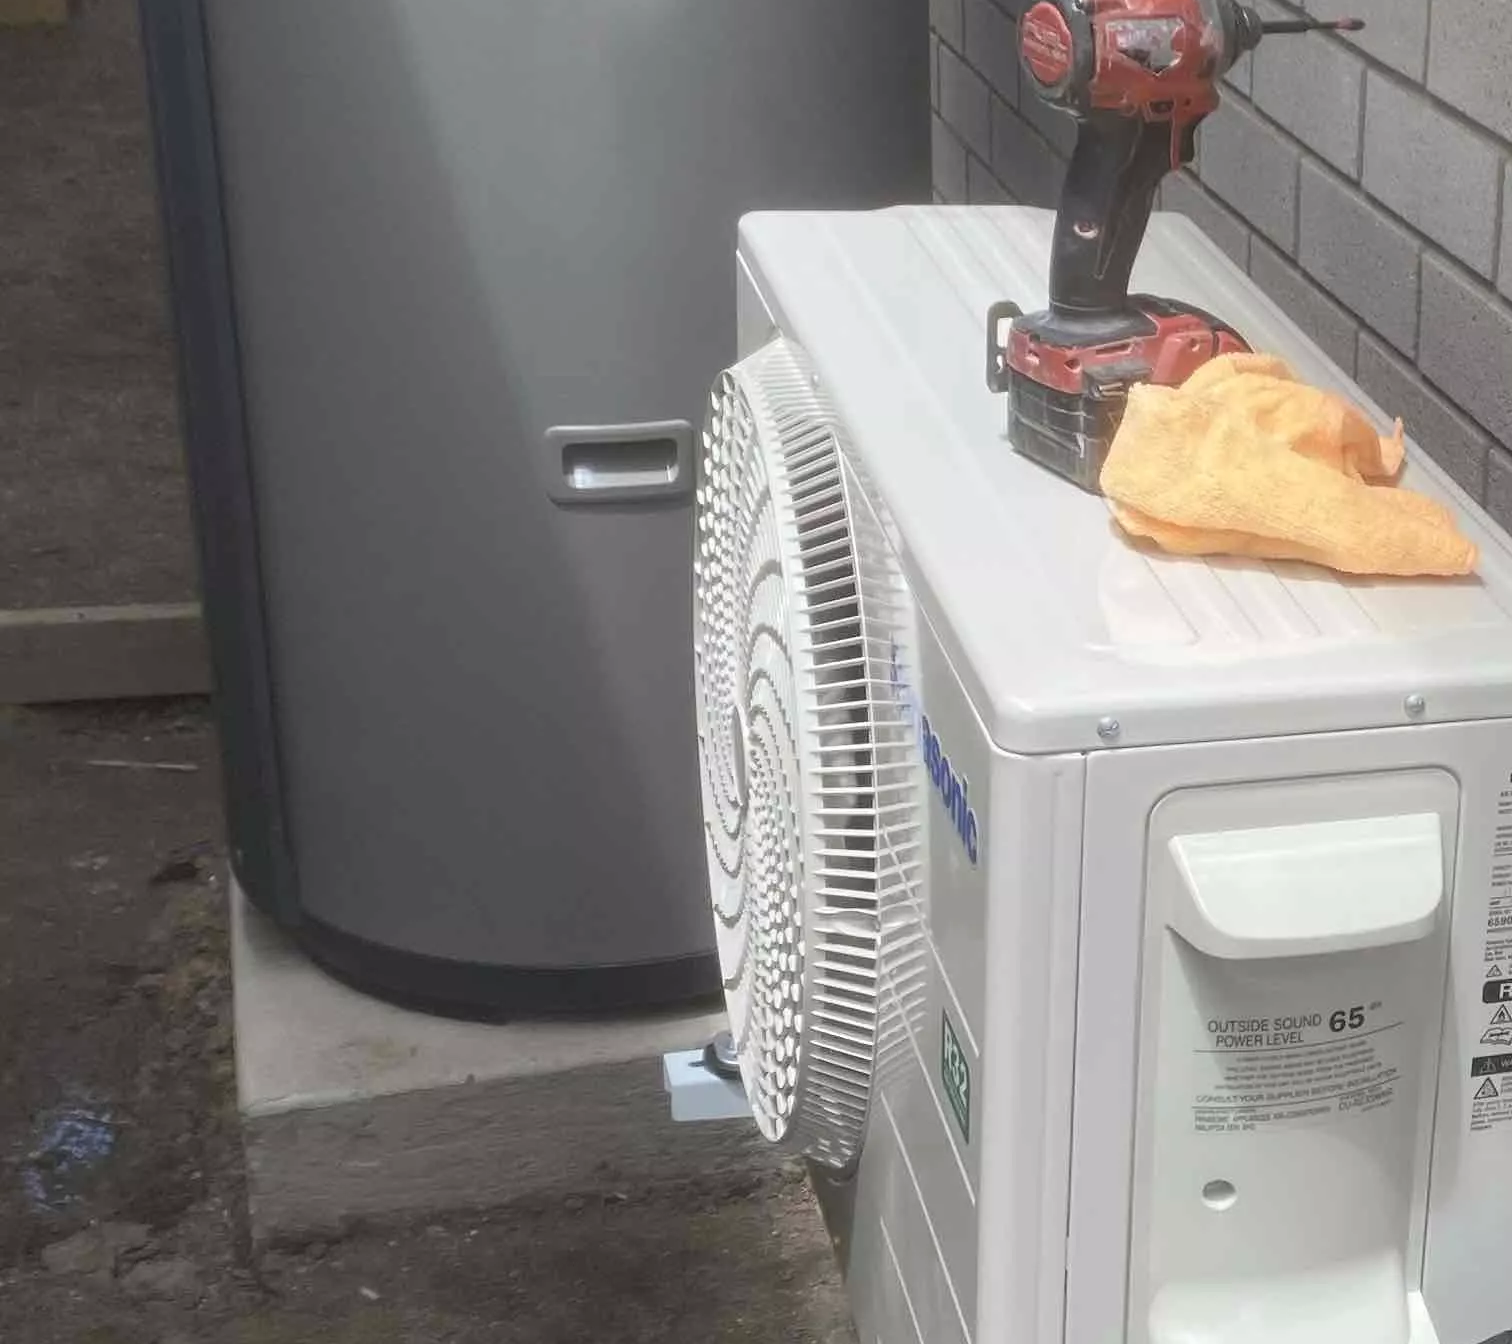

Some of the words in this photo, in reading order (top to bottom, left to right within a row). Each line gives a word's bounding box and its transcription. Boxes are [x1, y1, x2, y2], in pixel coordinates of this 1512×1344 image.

[1207, 1018, 1269, 1033] OUTSIDE
[1273, 1013, 1322, 1031] SOUND
[1328, 1005, 1366, 1033] 65
[1215, 1033, 1263, 1048] POWER
[1266, 1031, 1304, 1045] LEVEL
[944, 1021, 968, 1108] R32
